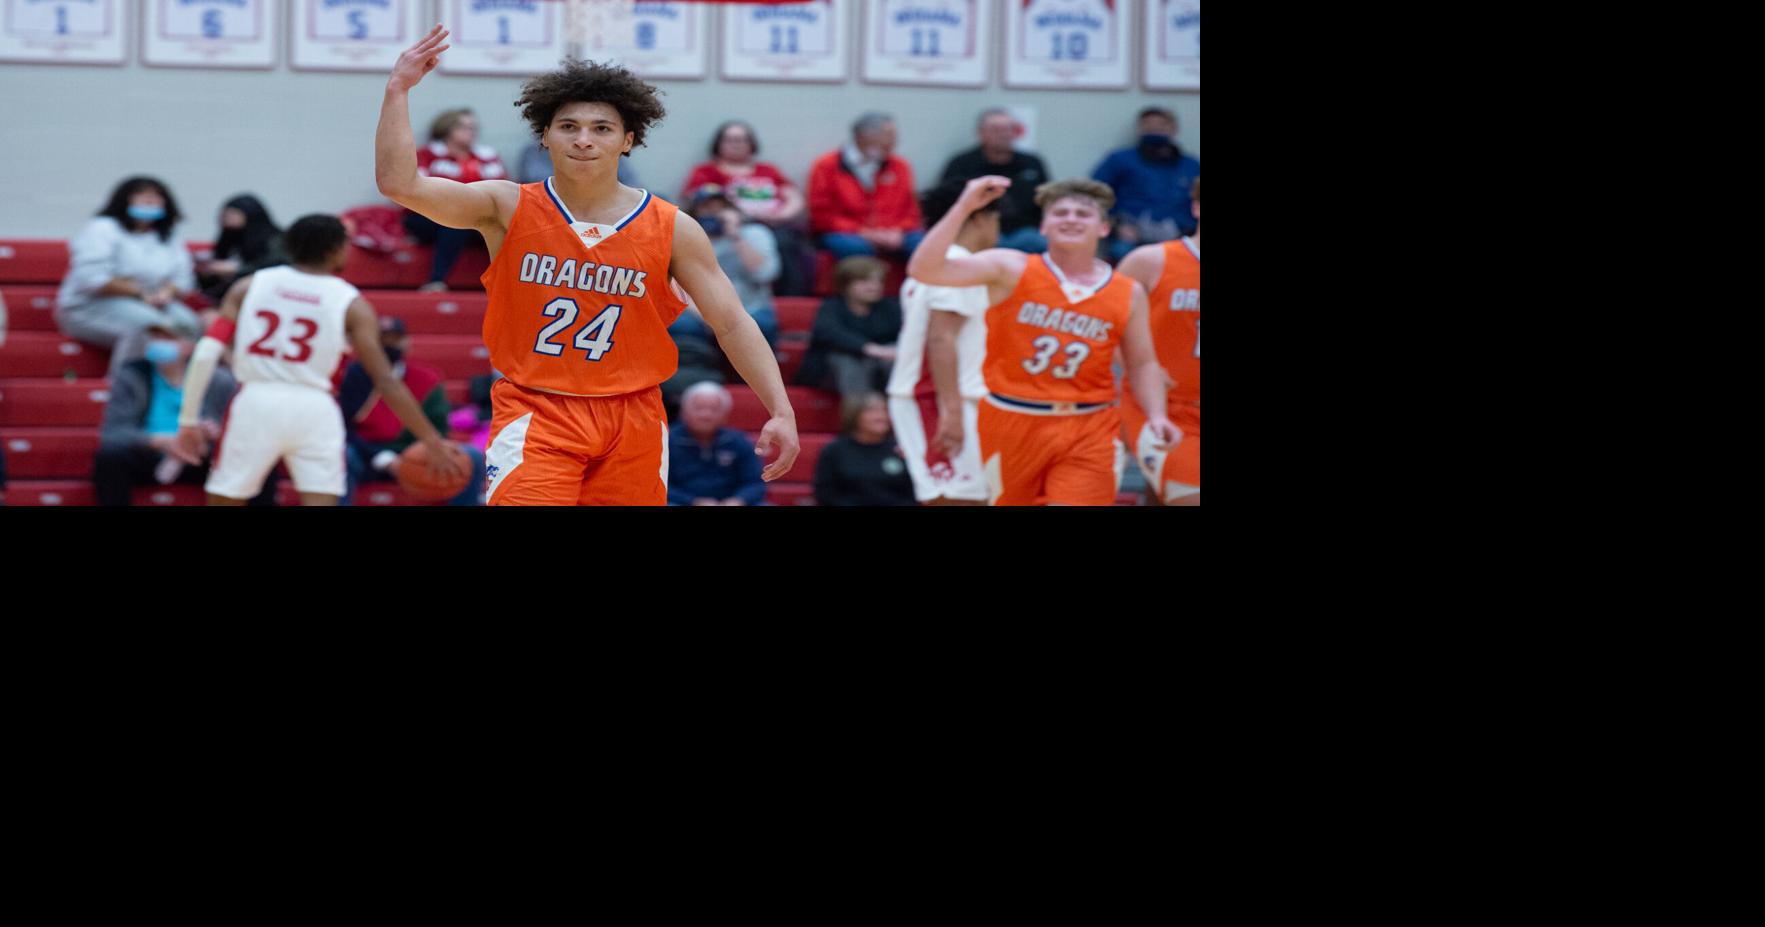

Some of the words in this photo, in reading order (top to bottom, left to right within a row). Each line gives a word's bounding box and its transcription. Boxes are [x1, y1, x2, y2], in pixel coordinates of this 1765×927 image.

[519, 252, 648, 298] DRAGONS
[248, 309, 319, 363] 23
[533, 297, 622, 361] 24
[1016, 301, 1114, 342] DRAGONS
[1022, 335, 1090, 379] 33
